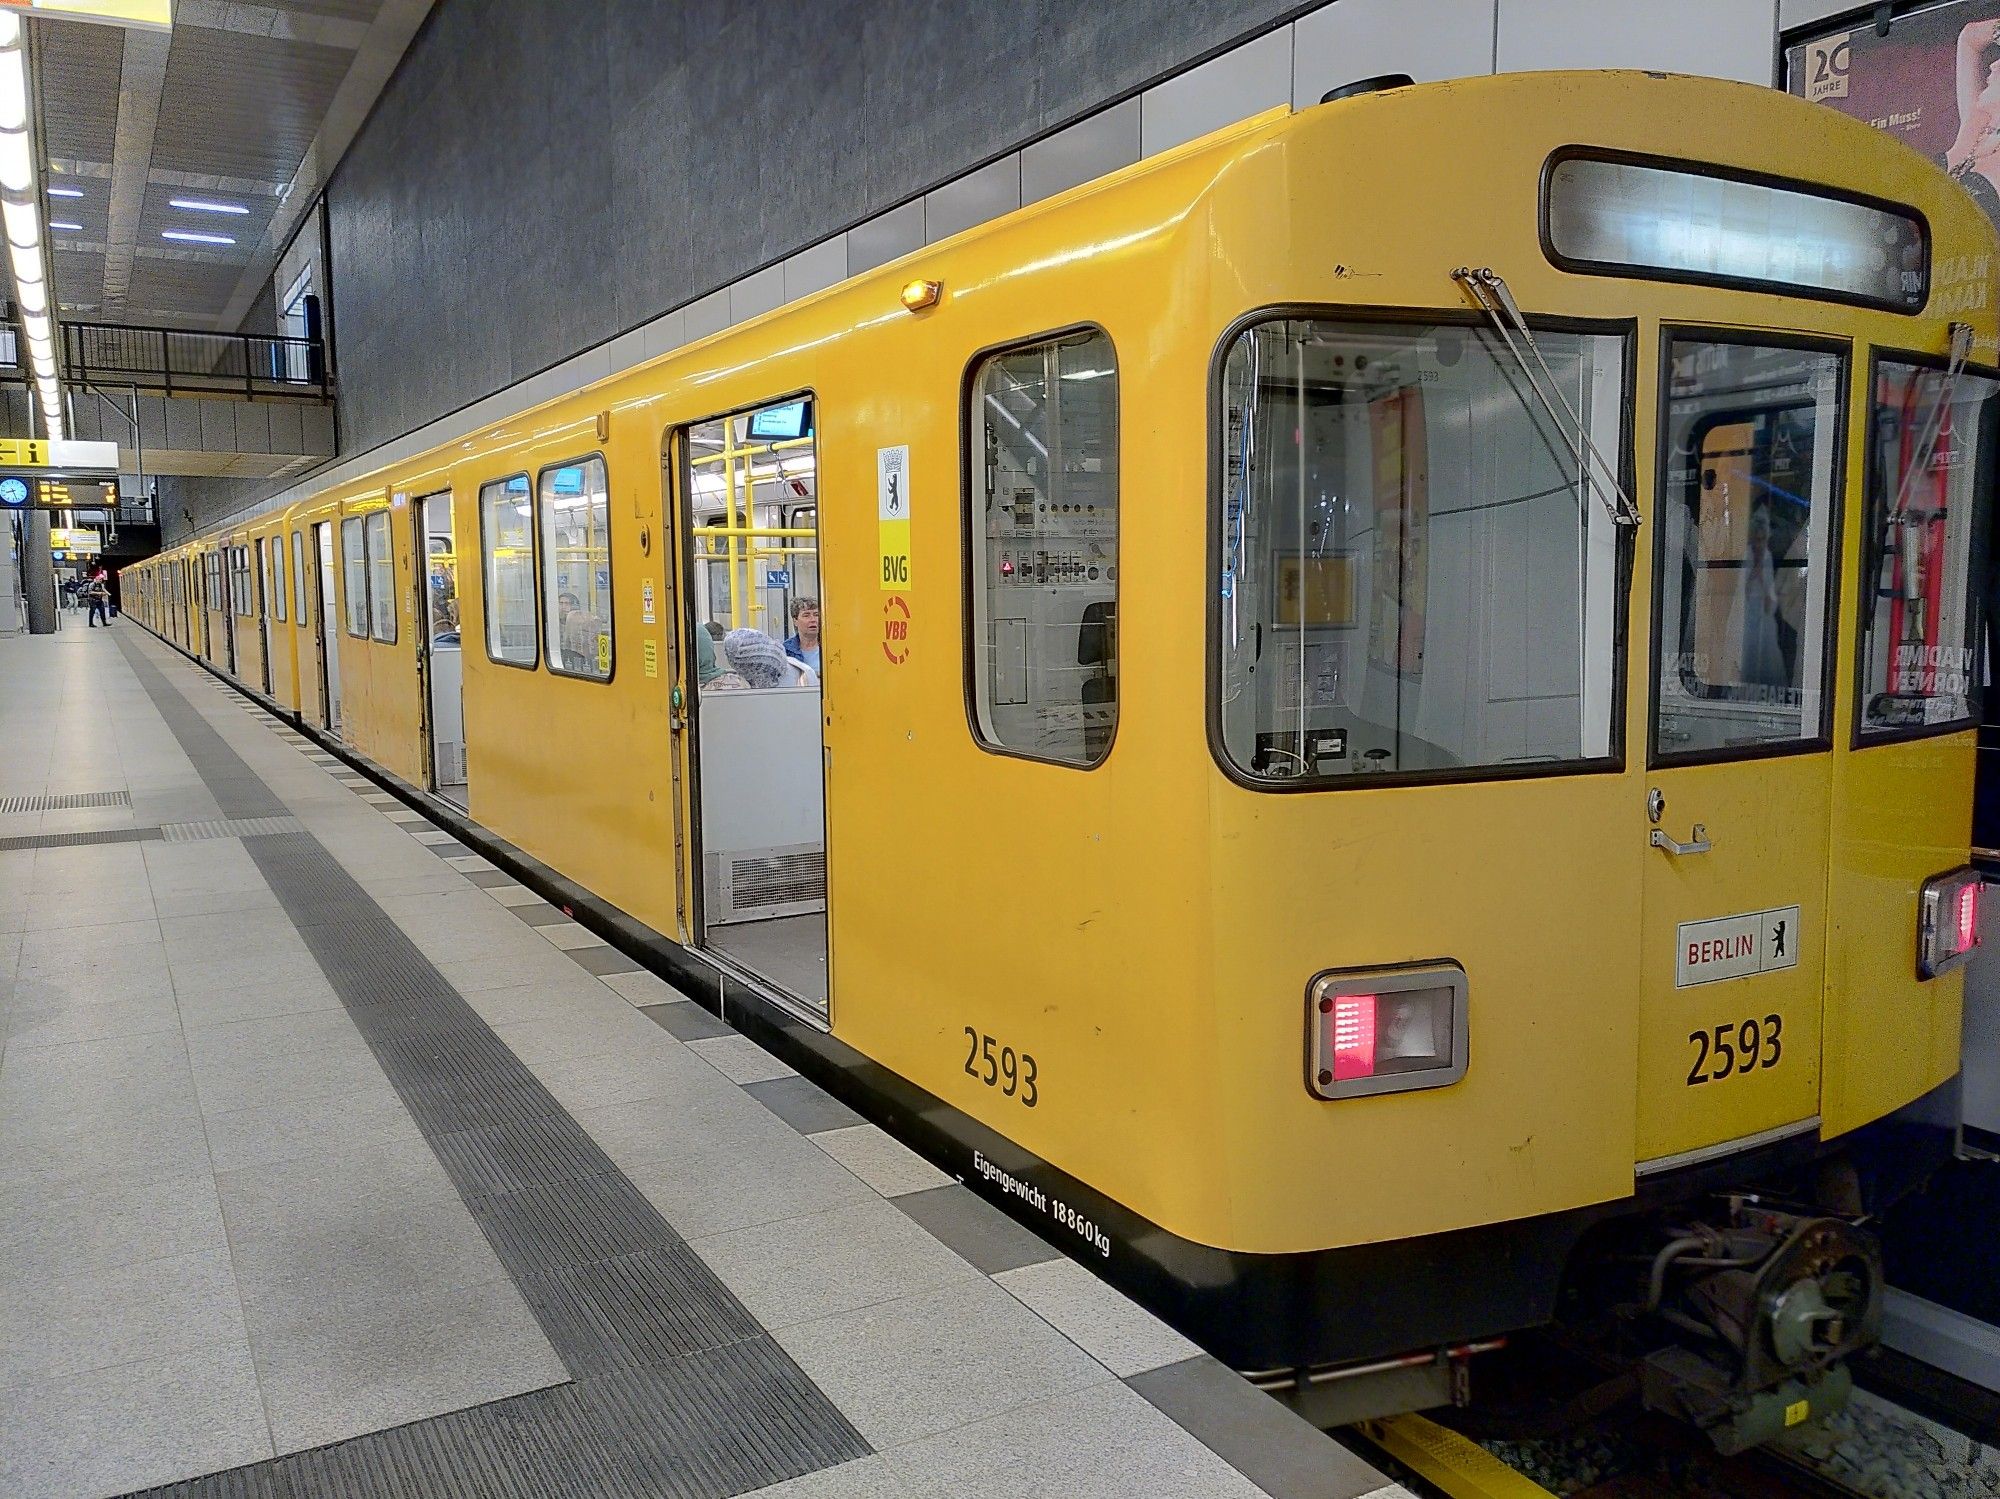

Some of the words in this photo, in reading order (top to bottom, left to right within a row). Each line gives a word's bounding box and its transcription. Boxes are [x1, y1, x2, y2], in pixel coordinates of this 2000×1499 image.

[1813, 81, 1841, 96] JAHRE
[1888, 108, 1921, 127] Muss!
[883, 555, 908, 582] BVG
[884, 620, 908, 640] VBB
[1688, 933, 1754, 966] BERLIN
[1687, 1013, 1782, 1086] 2593
[964, 1025, 1039, 1108] 2593
[973, 1149, 1047, 1213] Eigengewicht
